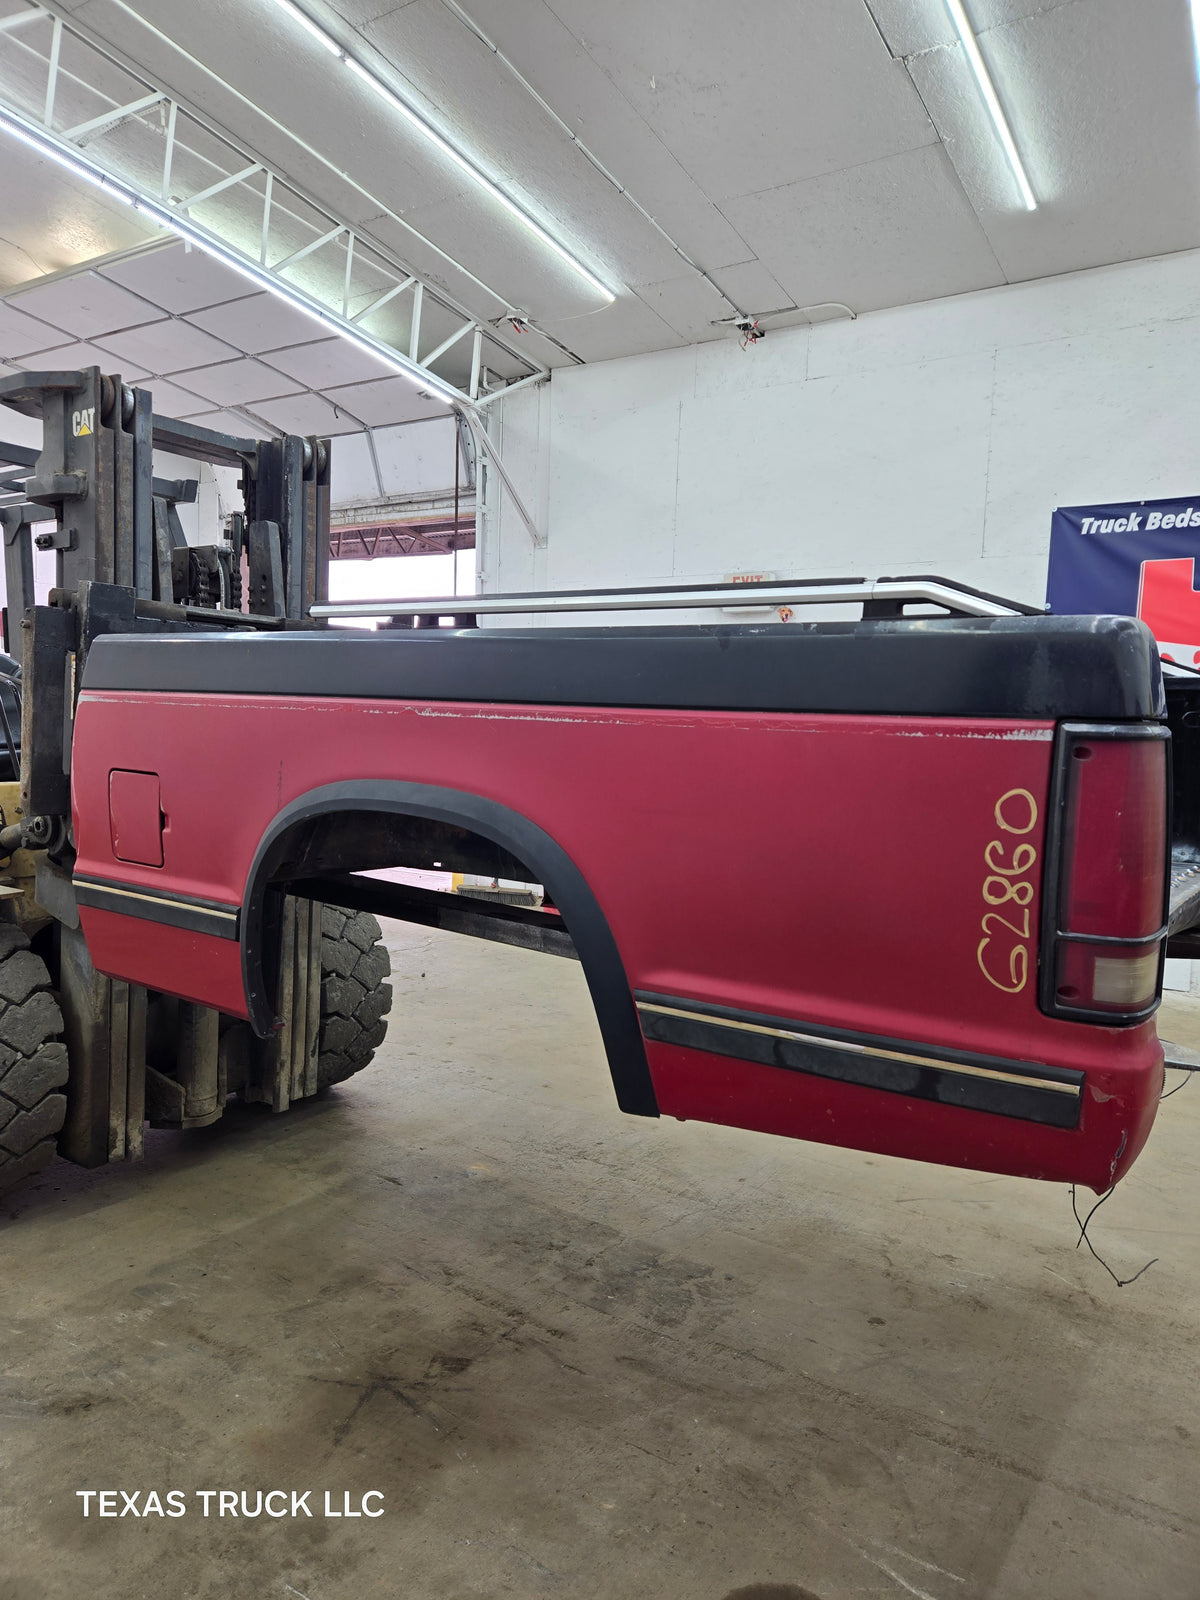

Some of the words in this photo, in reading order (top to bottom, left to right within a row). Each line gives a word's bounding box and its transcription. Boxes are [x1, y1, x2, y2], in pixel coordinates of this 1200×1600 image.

[72, 407, 95, 437] CAT
[1081, 512, 1143, 535] Truck
[1145, 508, 1200, 531] Beds
